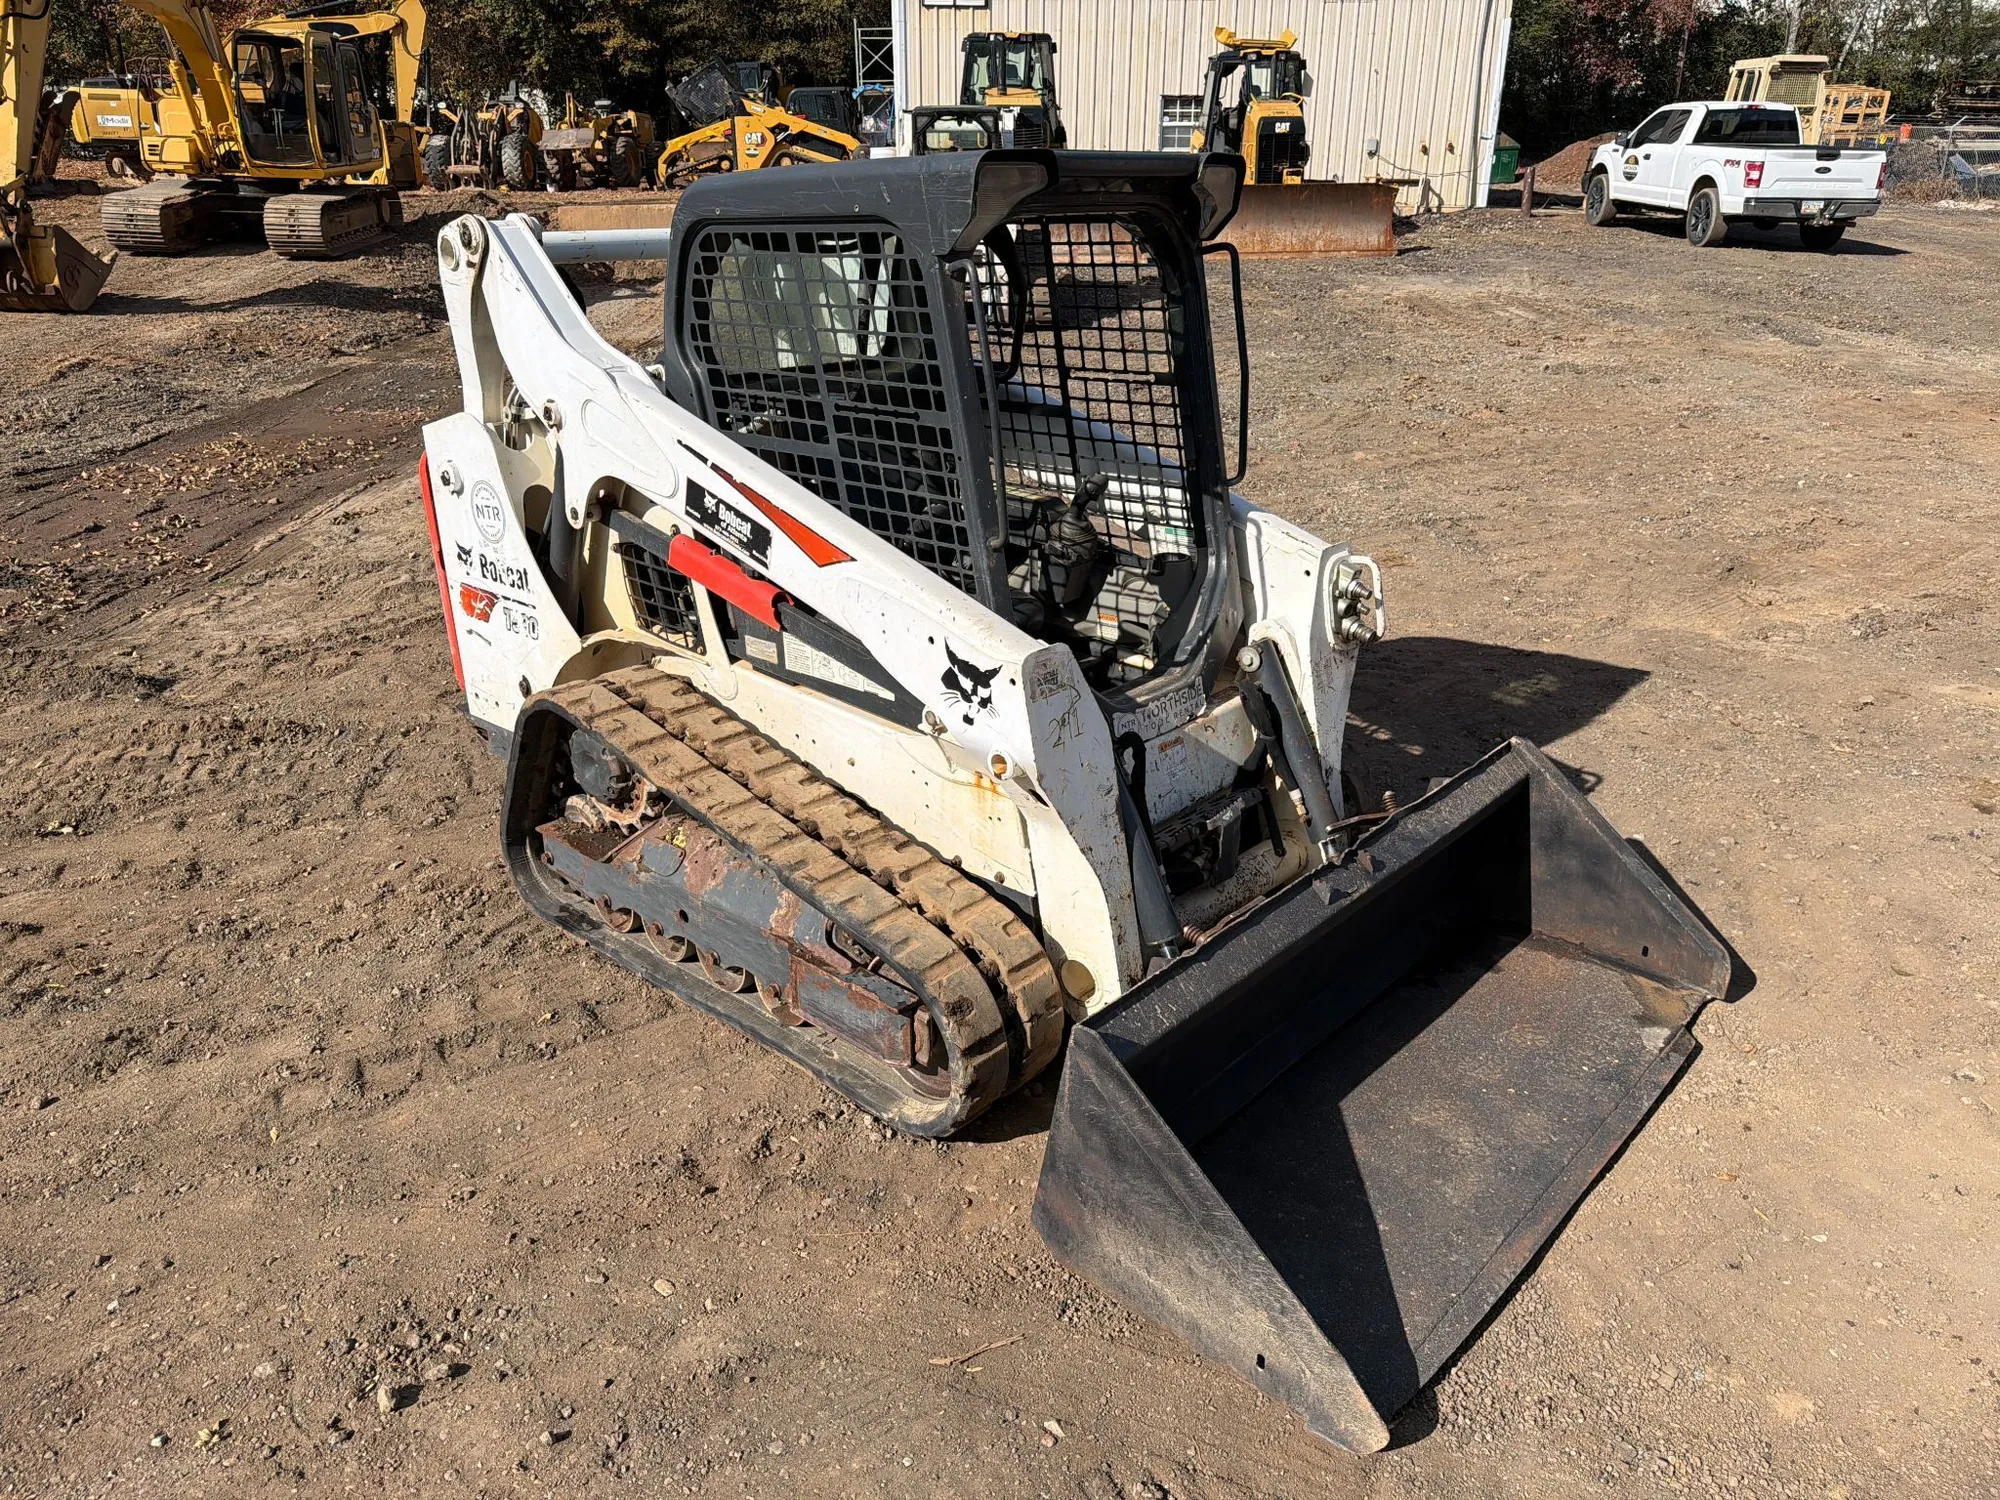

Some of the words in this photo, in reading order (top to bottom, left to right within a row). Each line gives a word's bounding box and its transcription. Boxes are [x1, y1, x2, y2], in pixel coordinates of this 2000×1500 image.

[1275, 122, 1291, 133] CAT
[745, 132, 762, 145] CAT
[1723, 159, 1741, 168] FX4
[475, 503, 501, 522] NTR
[719, 503, 751, 538] Bobcat
[1142, 685, 1202, 722] NORTHSIDE
[1173, 700, 1204, 719] RENTAL
[1121, 719, 1136, 730] NTR
